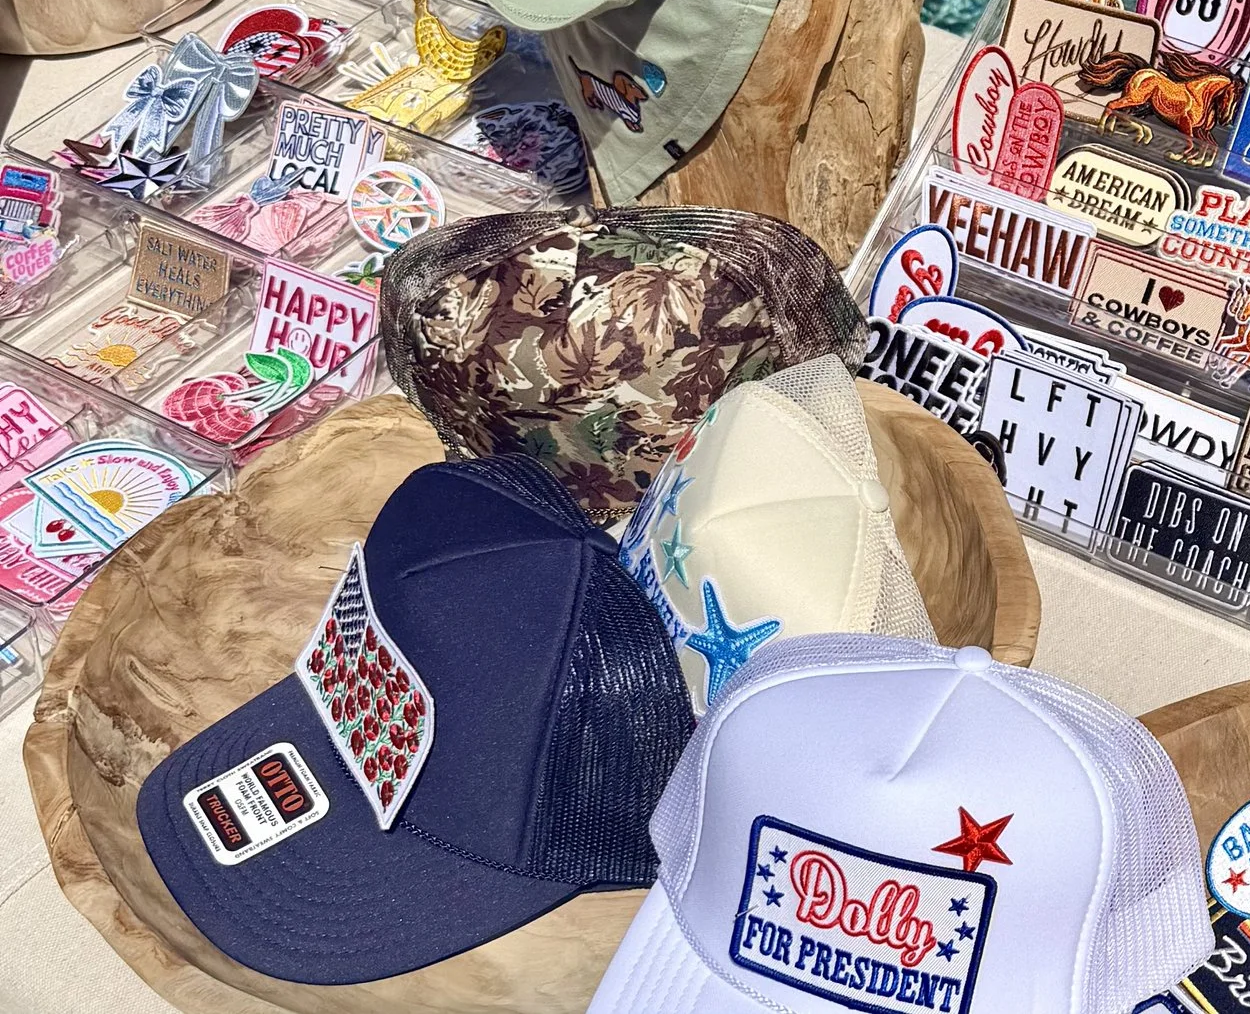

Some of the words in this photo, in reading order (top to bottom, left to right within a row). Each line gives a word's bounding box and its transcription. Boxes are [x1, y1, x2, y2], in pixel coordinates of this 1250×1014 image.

[280, 106, 366, 145] PRETTY
[967, 67, 1011, 175] Cowboy
[1011, 100, 1032, 133] THE
[275, 132, 345, 168] MUCH
[269, 159, 342, 195] LOCAL
[1061, 160, 1171, 212] AMERICAN
[1067, 188, 1140, 231] DREAM
[5, 240, 54, 270] COFFEE
[146, 235, 174, 257] SALT
[177, 246, 218, 273] WATER
[929, 183, 1087, 291] YEEHAW
[12, 255, 51, 279] LOVER
[158, 260, 201, 289] HEALS
[263, 275, 370, 344] HAPPY
[1141, 277, 1156, 305] I
[1082, 311, 1100, 328] &
[1107, 320, 1204, 366] COFFEE
[1087, 292, 1211, 347] COWBOYS
[97, 455, 138, 467] Slow
[137, 457, 163, 474] and
[157, 464, 181, 492] Enjoy
[1143, 481, 1203, 535] DIBS
[1213, 506, 1249, 553] ON
[1114, 516, 1159, 568] THE
[1165, 537, 1249, 601] COACH
[233, 798, 250, 817] OSFM
[234, 781, 253, 805] FOAM
[248, 799, 268, 825] FRONT
[241, 772, 259, 797] WORLD
[256, 794, 280, 828] FAMOUS
[260, 760, 305, 812] OTTO
[206, 793, 243, 844] TRUCKER
[304, 810, 321, 822] SOFT
[789, 849, 937, 968] Dolly
[742, 914, 794, 967] FOR
[795, 935, 962, 1013] PRESIDENT
